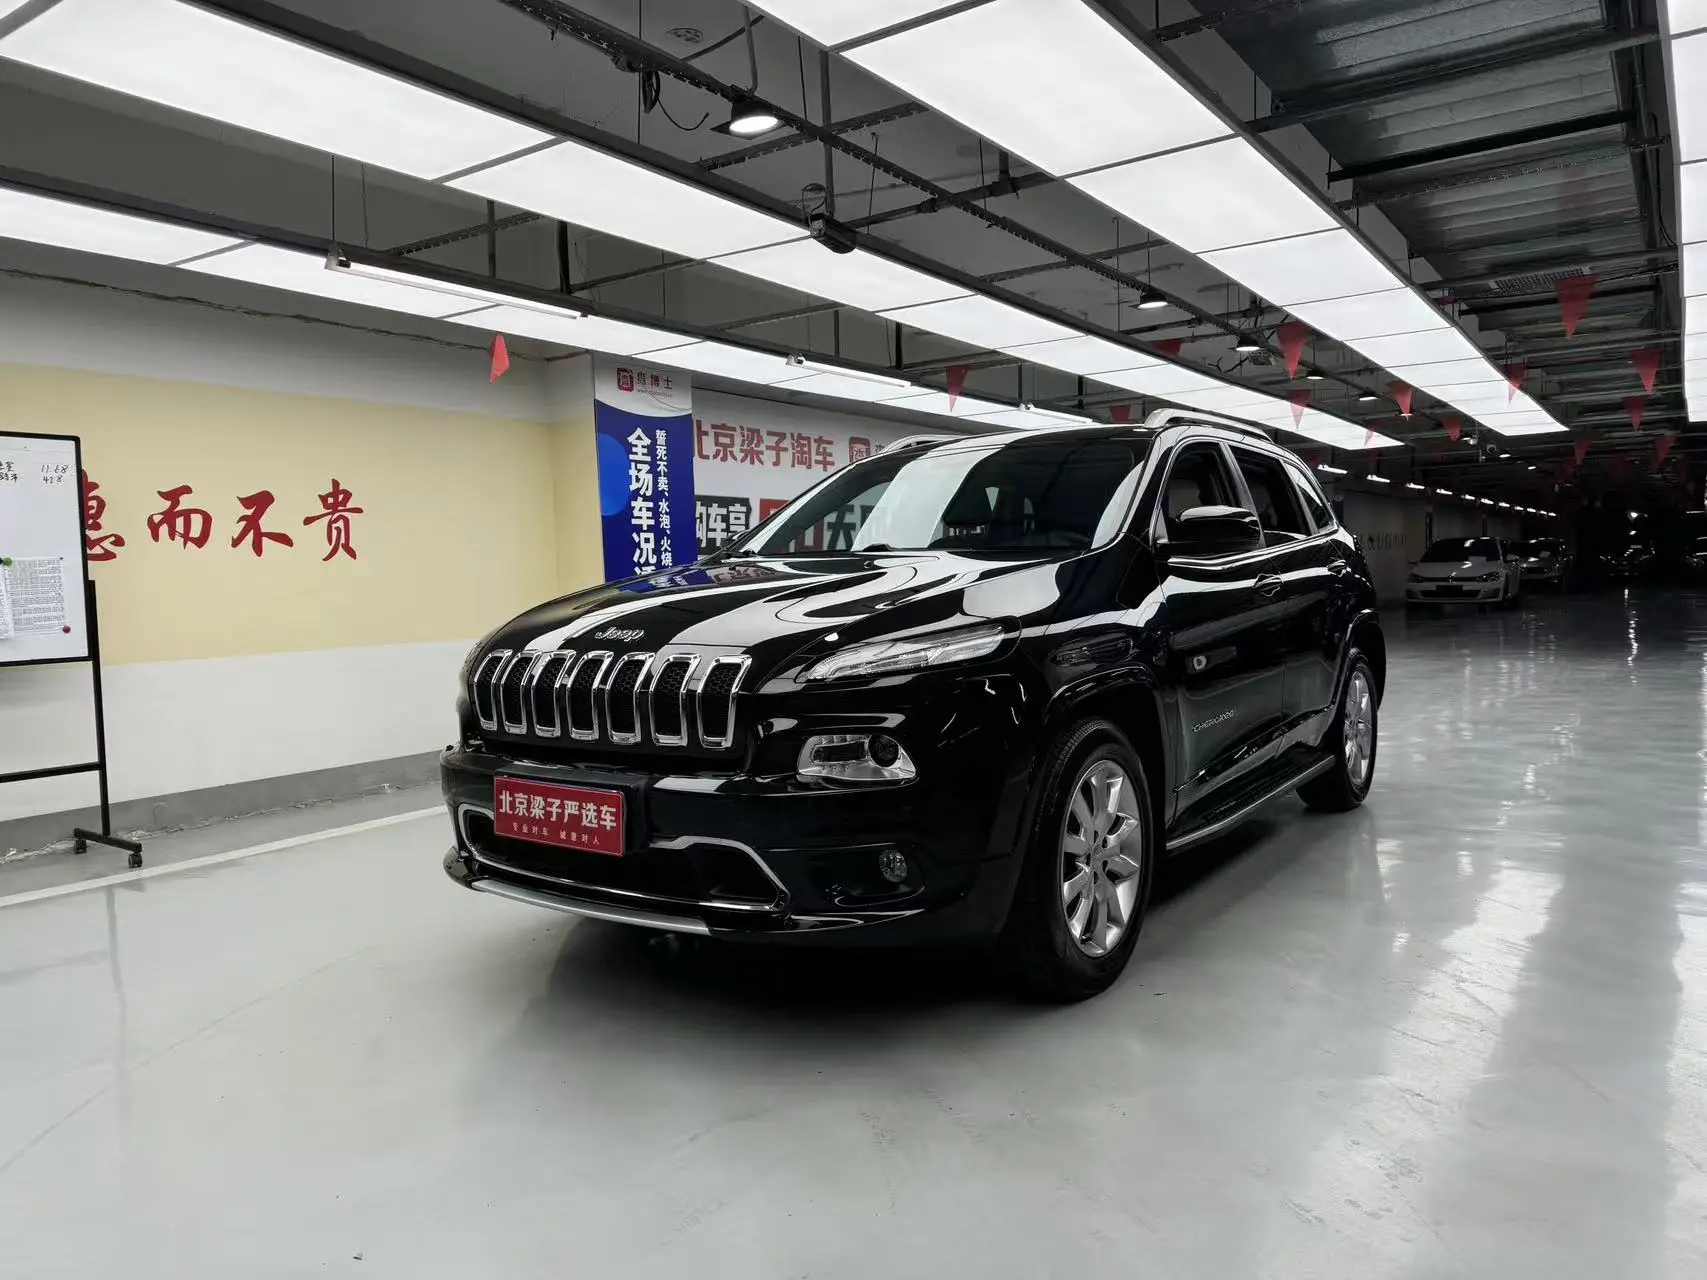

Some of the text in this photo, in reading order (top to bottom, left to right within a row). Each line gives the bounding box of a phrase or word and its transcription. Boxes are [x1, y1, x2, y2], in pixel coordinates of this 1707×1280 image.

[595, 627, 644, 643] Jeep
[499, 789, 616, 830] 北京梁子严选车
